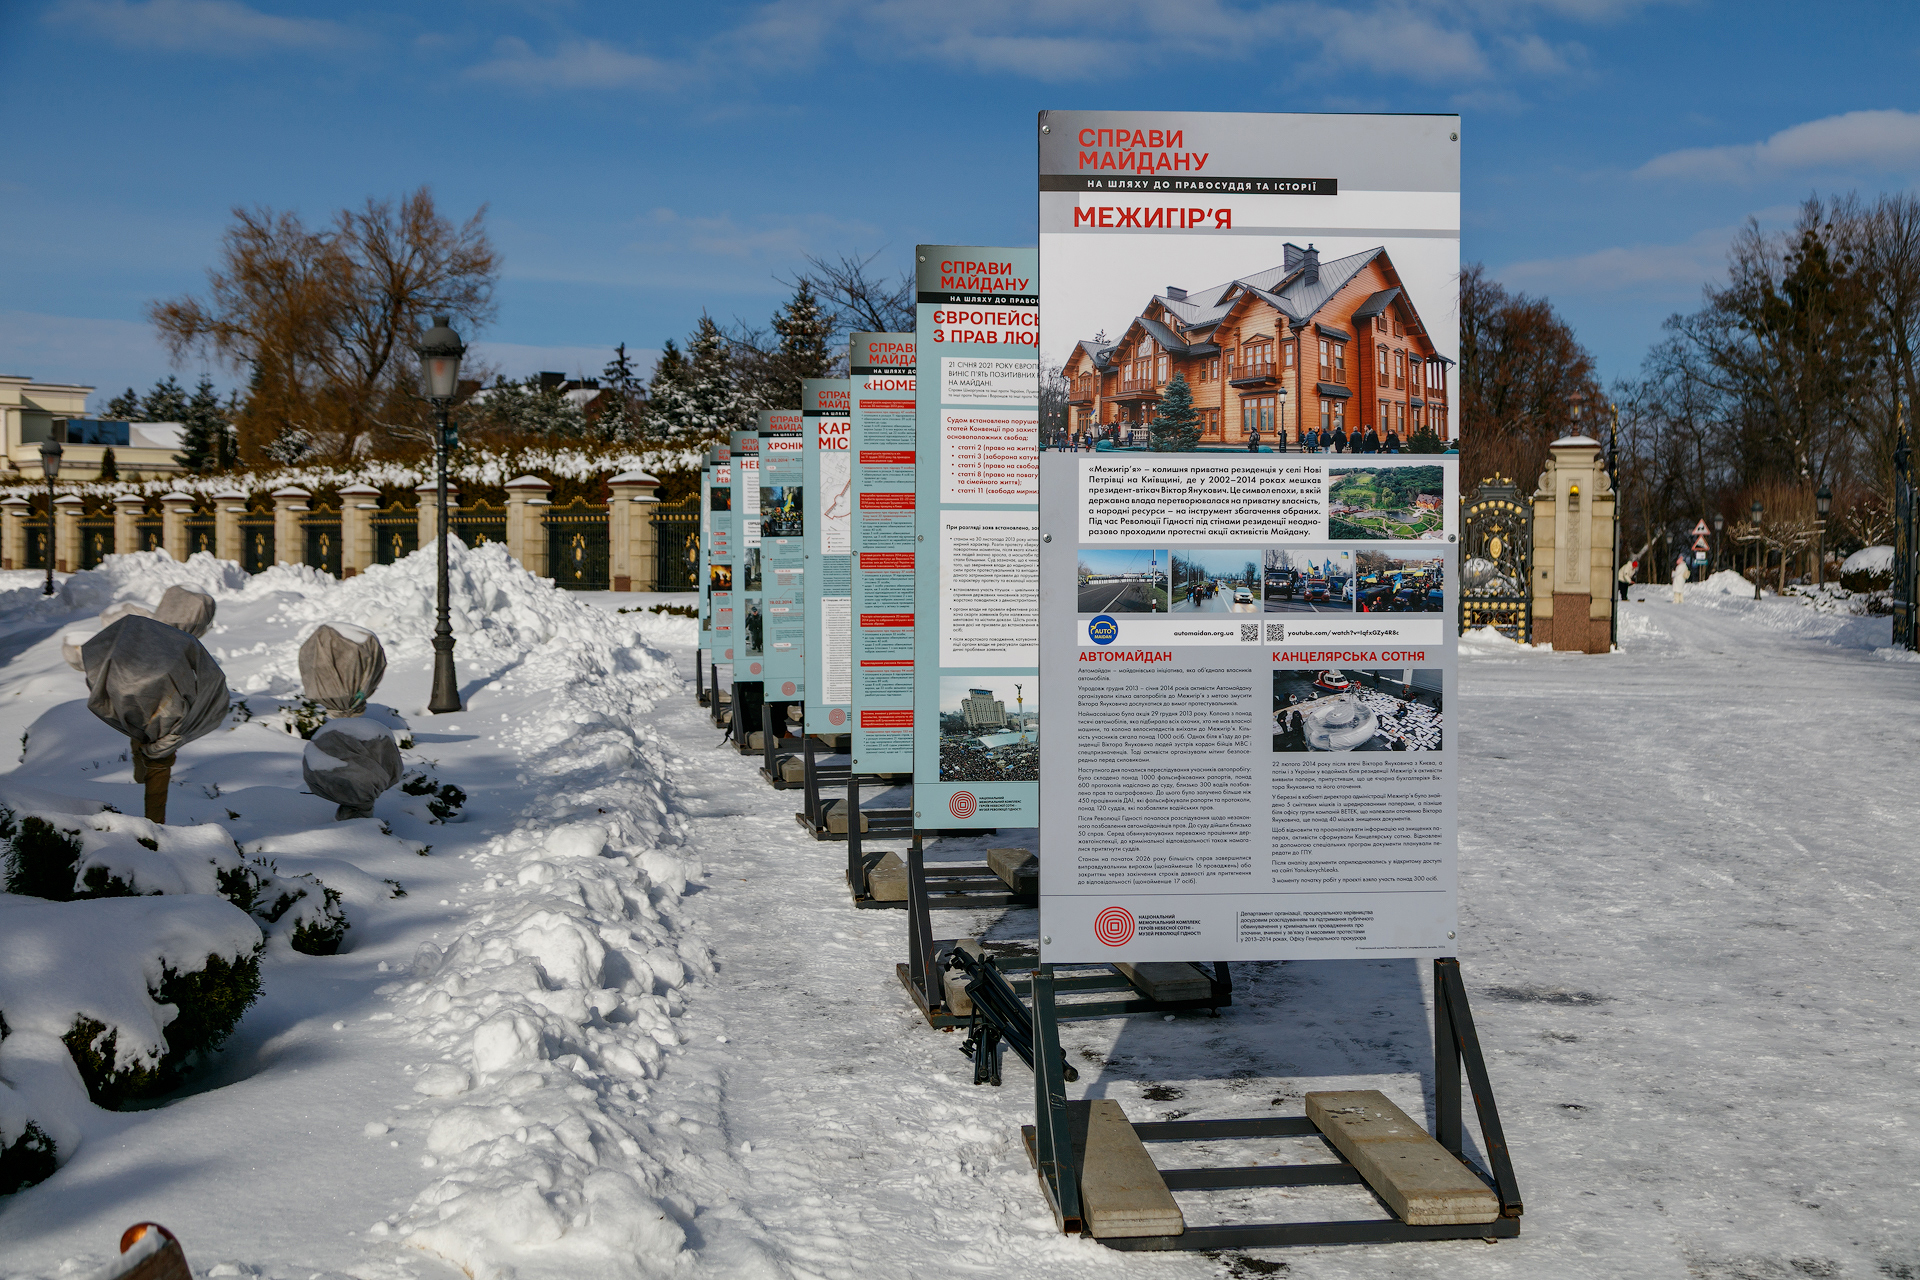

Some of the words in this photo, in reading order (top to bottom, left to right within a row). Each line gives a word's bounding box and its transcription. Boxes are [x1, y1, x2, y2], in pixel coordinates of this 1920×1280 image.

[1079, 129, 1182, 148] СПРАВИ
[1079, 148, 1208, 174] МАЙДАНУ
[1154, 181, 1170, 190] ДО
[1176, 182, 1251, 191] ПРАВОСУДДЯ
[1275, 181, 1316, 191] ІСТОРІЇ
[940, 260, 1012, 275] СПРАВИ
[941, 275, 1029, 293] МАЙДАНУ
[933, 329, 944, 343] З
[951, 330, 997, 344] ПРАВ
[819, 437, 848, 450] МІС
[1231, 466, 1276, 474] резиденція
[1089, 476, 1124, 484] Петрівці
[1142, 476, 1182, 484] Київщині,
[1161, 486, 1187, 495] Віктор
[1188, 486, 1229, 495] Янукович.
[1230, 487, 1241, 495] Це
[1096, 507, 1129, 516] народні
[1283, 507, 1321, 516] обраних.
[1163, 518, 1194, 526] Гідності
[1196, 518, 1208, 526] під
[1243, 518, 1286, 526] резиденції
[1168, 528, 1206, 536] протестні
[1208, 528, 1228, 536] акції
[1271, 528, 1310, 537] Майдану.
[1079, 650, 1172, 663] АВТОМАЙДАН
[1273, 652, 1377, 663] КАНЦЕЛЯРСЬКА
[1381, 651, 1424, 661] СОТНЯ
